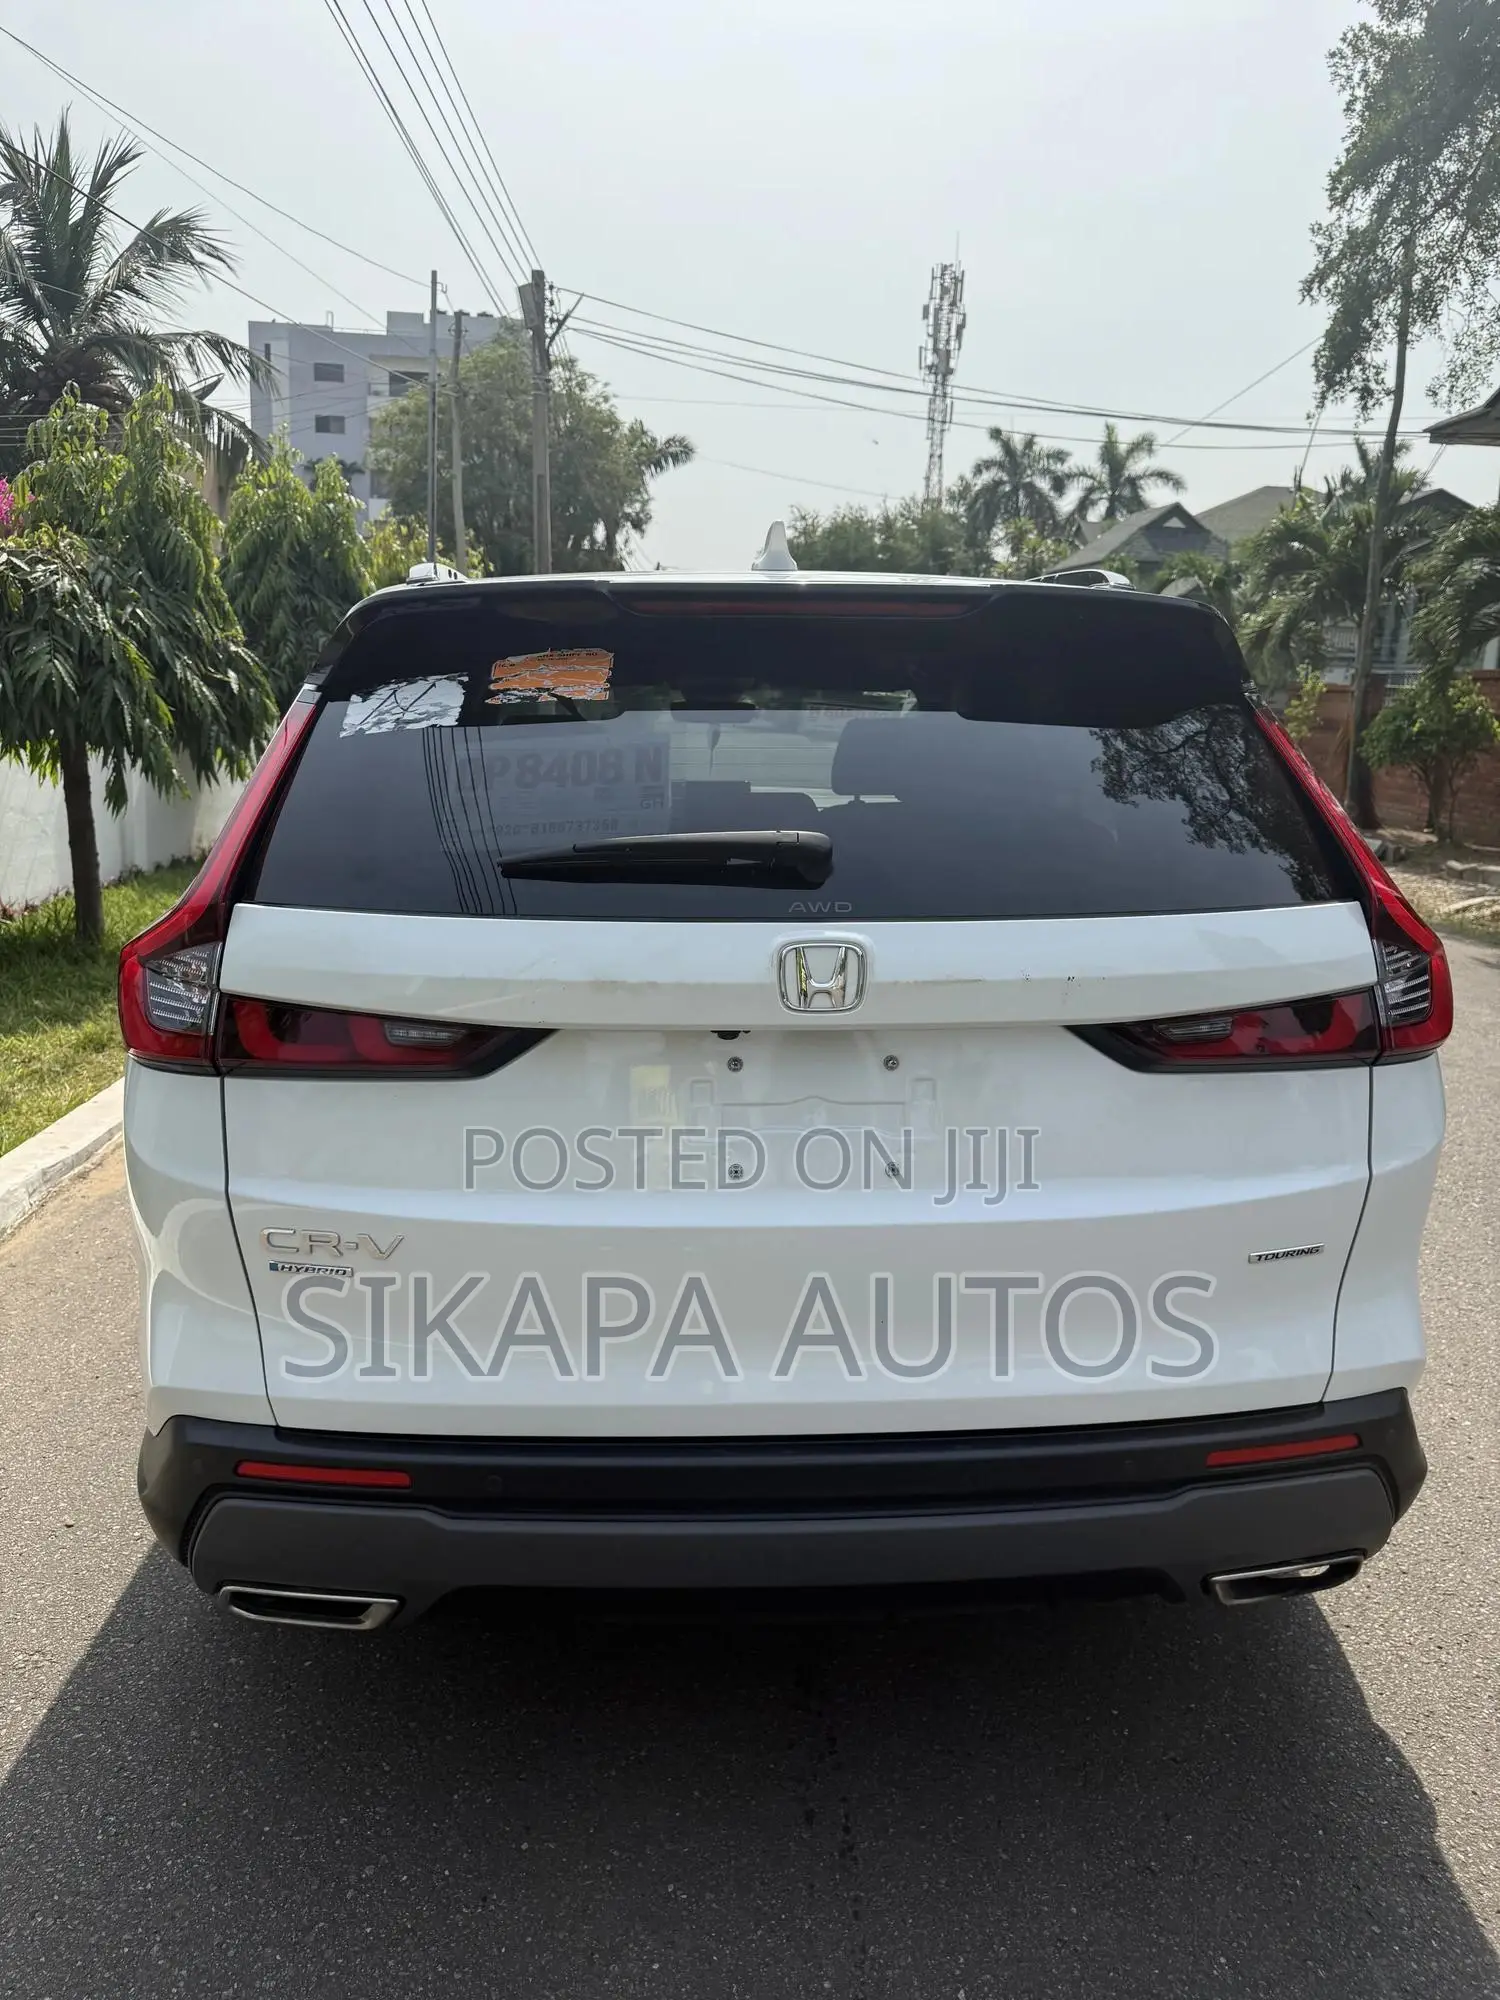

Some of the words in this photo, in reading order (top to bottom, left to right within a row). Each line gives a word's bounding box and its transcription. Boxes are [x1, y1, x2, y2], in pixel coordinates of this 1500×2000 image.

[514, 747, 626, 790] 8408
[634, 744, 663, 784] N
[788, 901, 853, 913] AWD
[260, 1227, 405, 1261] CR-V
[1255, 1246, 1321, 1262] TOURING
[279, 1263, 348, 1276] HYBRID
